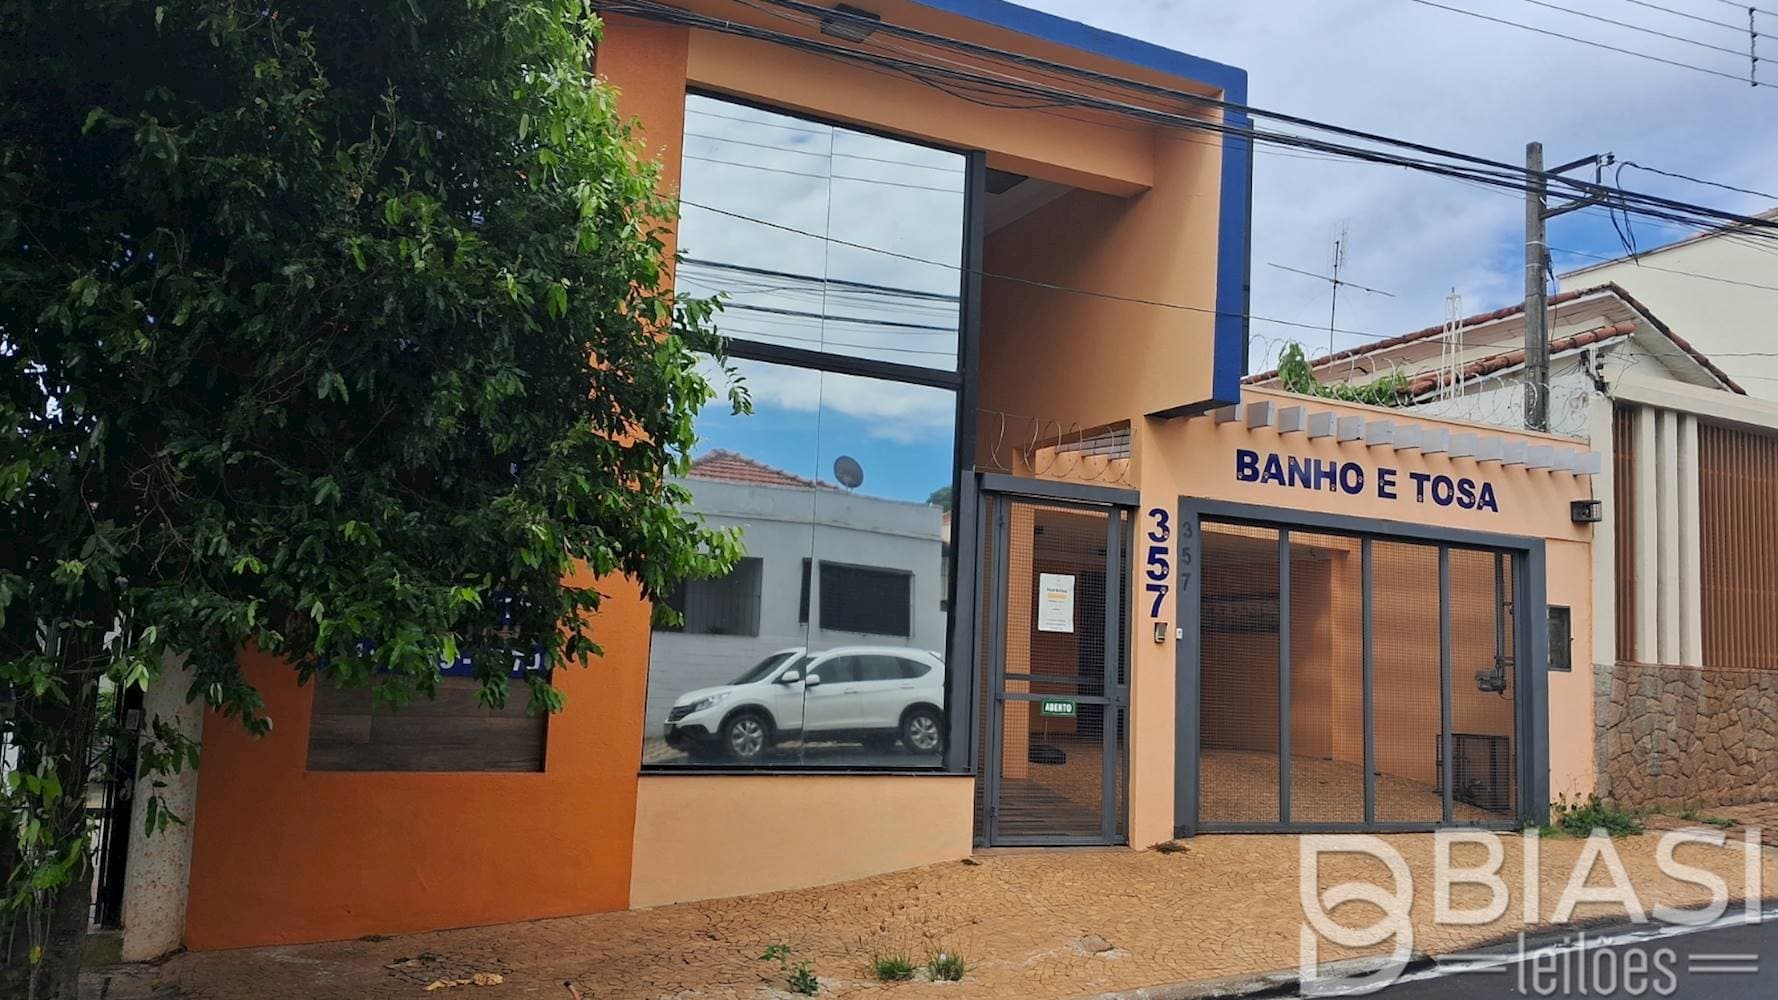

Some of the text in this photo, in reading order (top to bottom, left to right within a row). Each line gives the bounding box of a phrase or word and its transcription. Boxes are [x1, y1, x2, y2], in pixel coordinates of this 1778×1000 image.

[1236, 449, 1499, 513] BANHO E TOSA
[1146, 508, 1170, 618] 357
[1181, 521, 1193, 592] 357
[1044, 703, 1072, 713] ABERTO
